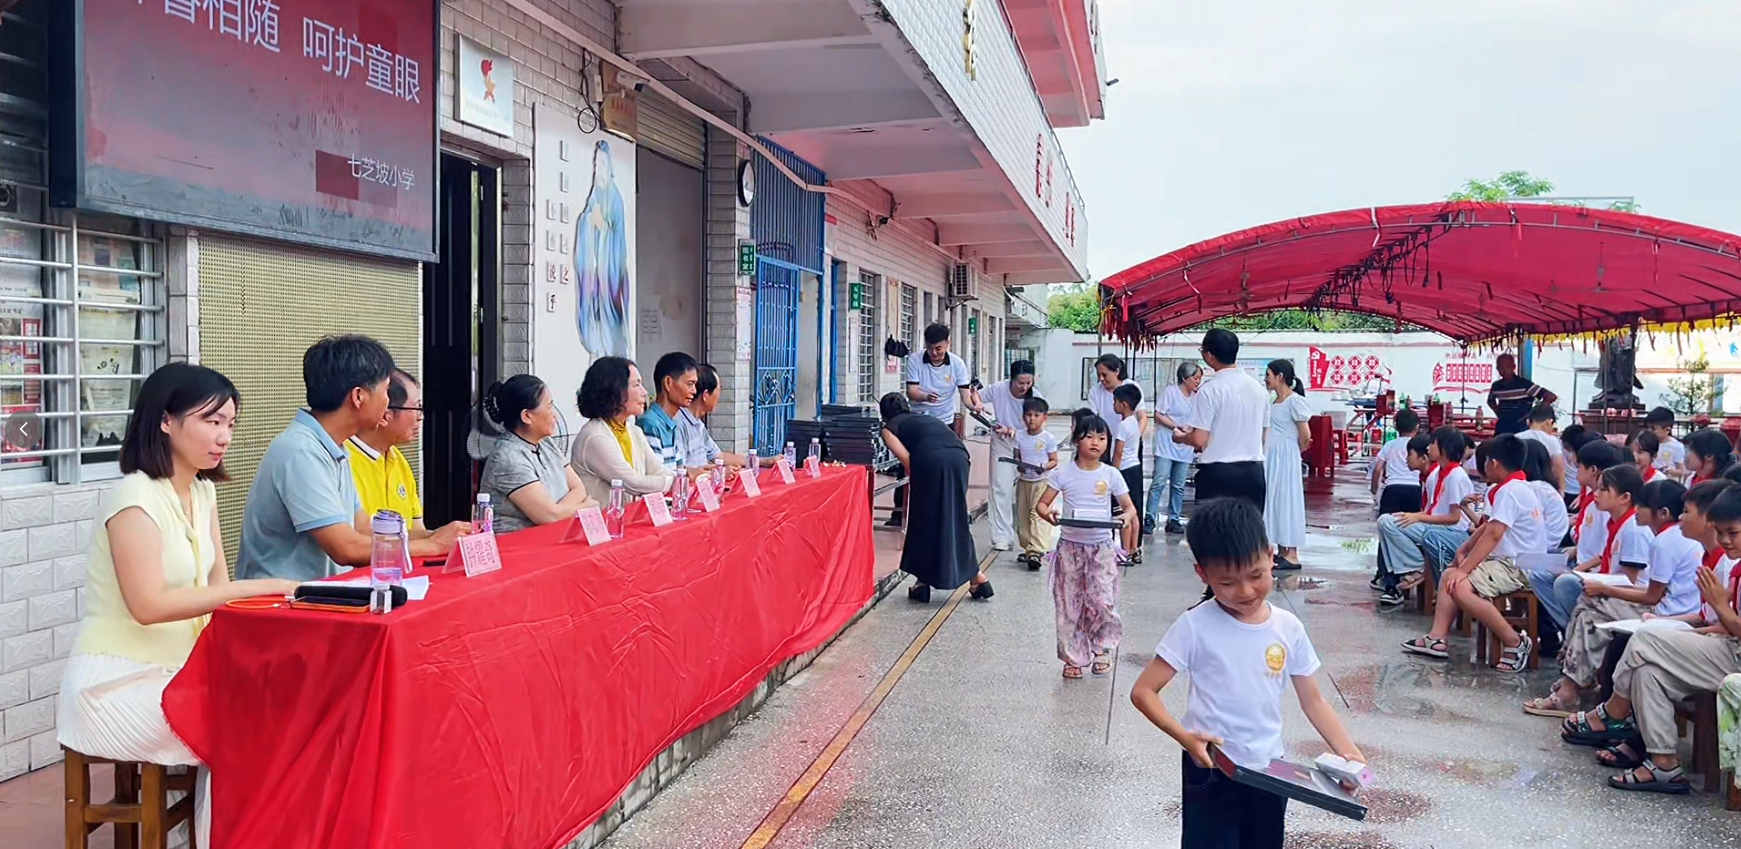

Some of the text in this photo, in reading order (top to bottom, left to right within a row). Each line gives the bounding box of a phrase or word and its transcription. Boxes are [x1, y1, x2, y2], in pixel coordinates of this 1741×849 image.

[138, 0, 420, 104] 相随 呵护童眼
[347, 153, 415, 190] 七芝坡小学
